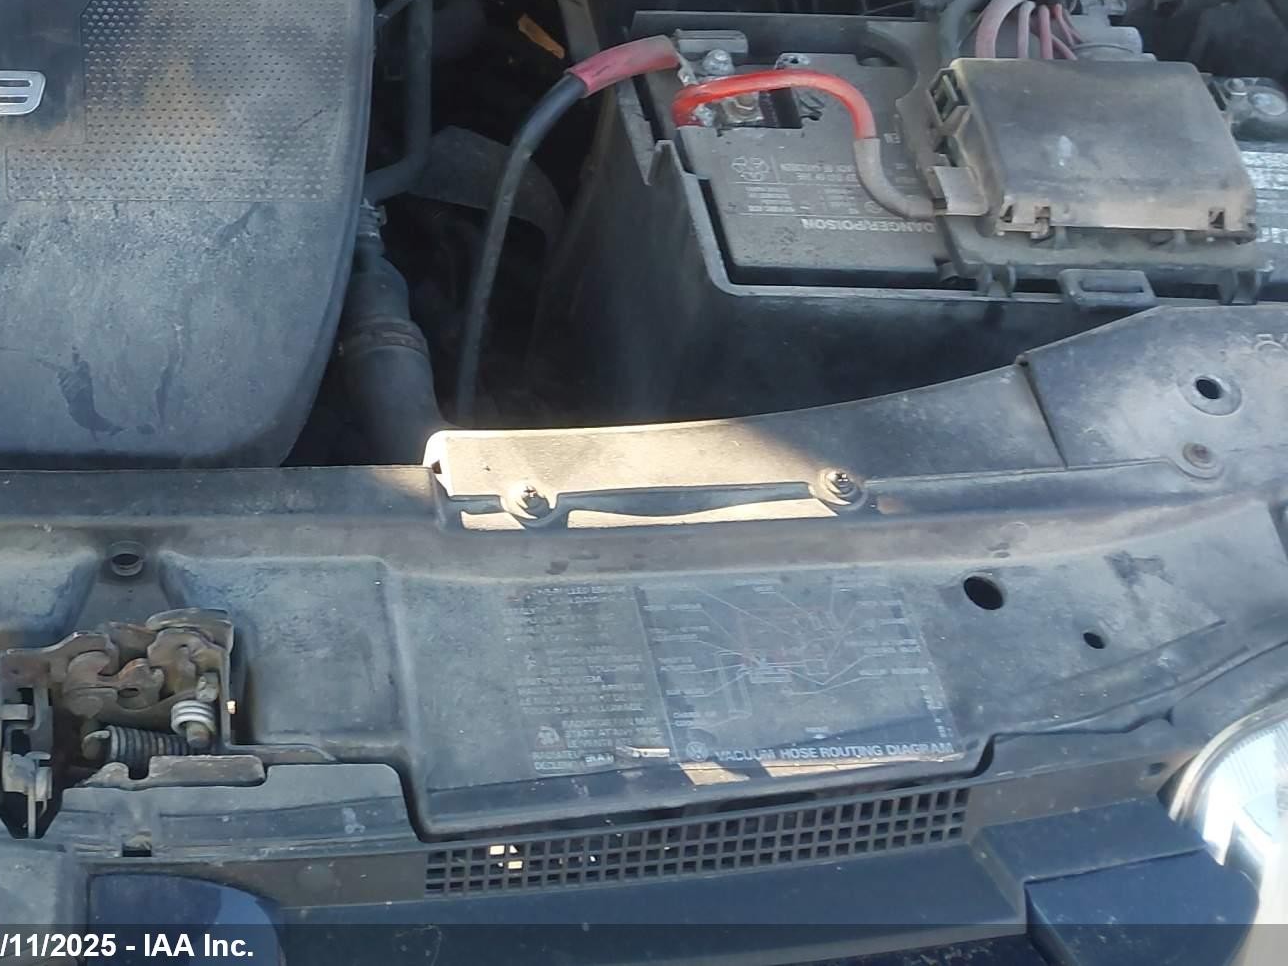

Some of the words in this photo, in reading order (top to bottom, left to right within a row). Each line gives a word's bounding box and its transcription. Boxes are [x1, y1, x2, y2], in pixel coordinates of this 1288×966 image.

[715, 749, 776, 762] VACUUM
[782, 746, 818, 759] HOSE
[820, 744, 882, 759] ROUTING
[886, 741, 954, 756] DIAGRAM
